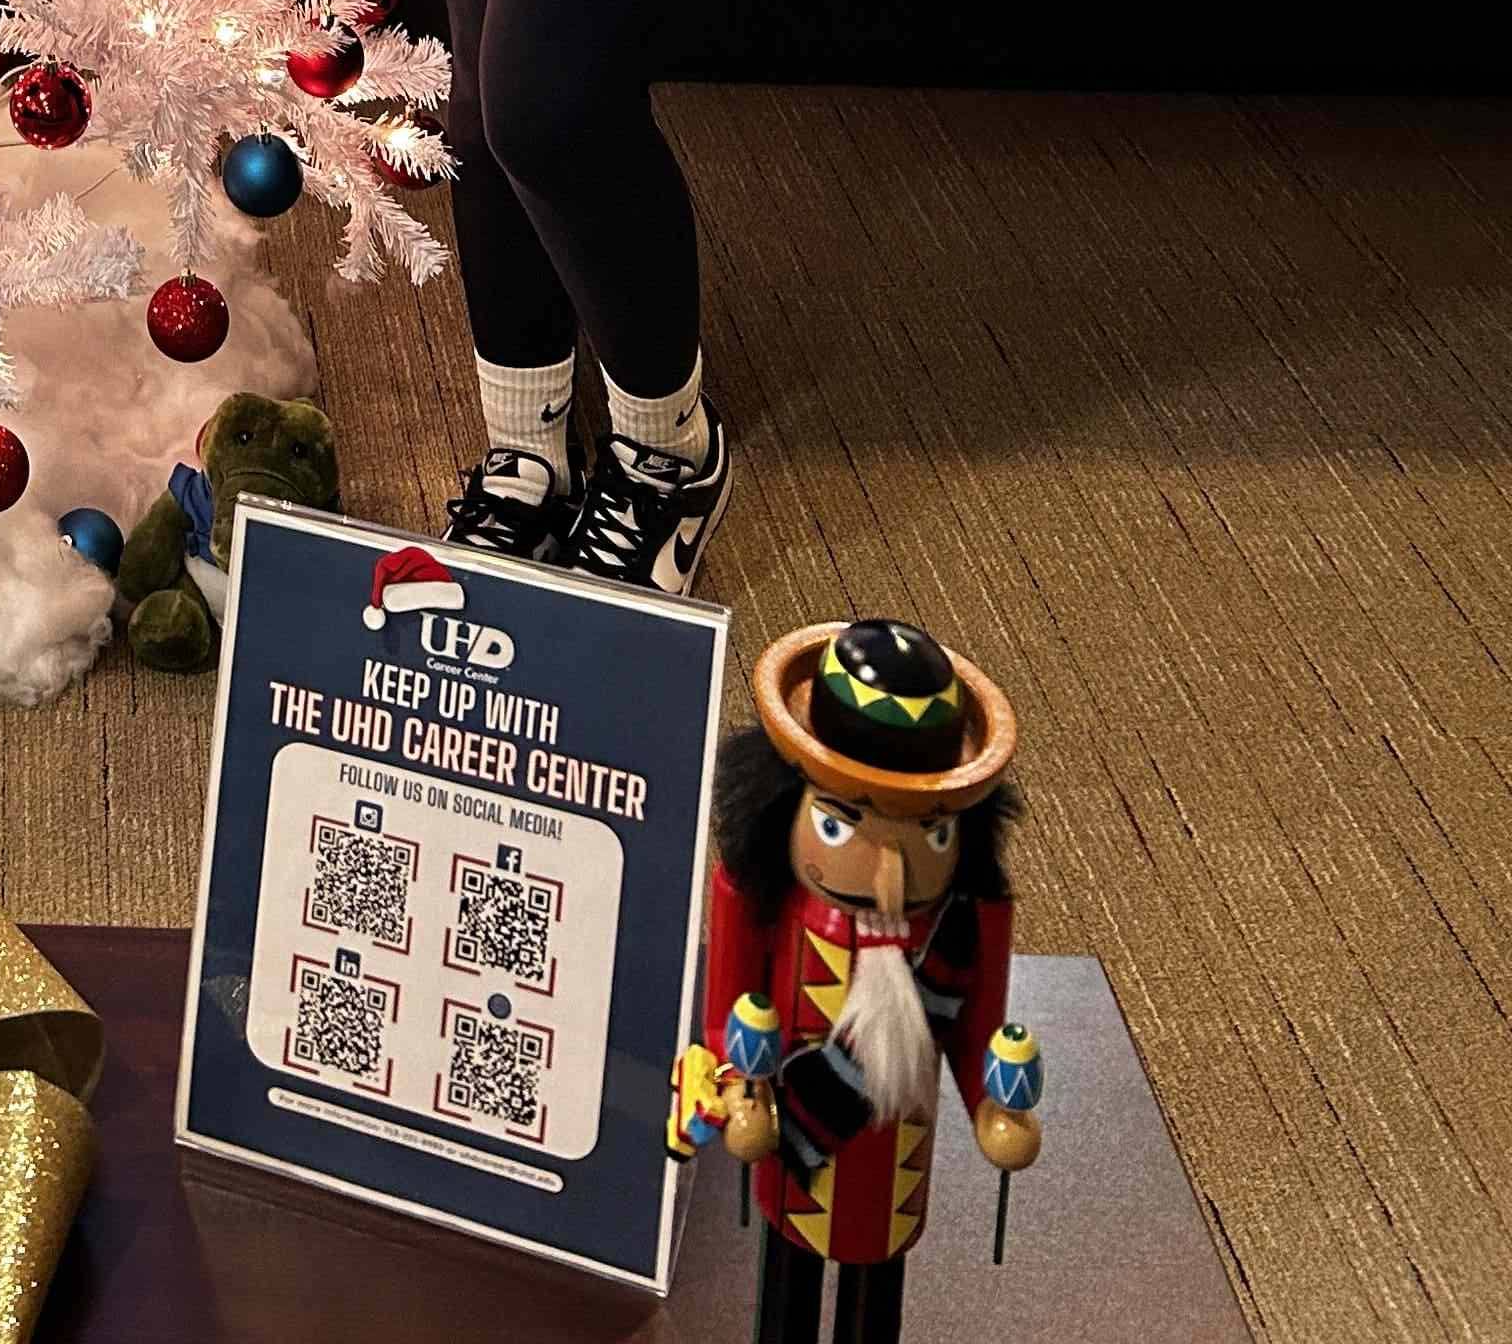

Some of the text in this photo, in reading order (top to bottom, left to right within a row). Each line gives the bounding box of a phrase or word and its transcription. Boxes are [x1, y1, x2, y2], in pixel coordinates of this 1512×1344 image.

[419, 611, 515, 669] UHD
[426, 656, 499, 684] Career Center
[362, 659, 560, 745] KEEP UP WITH
[269, 681, 648, 821] THE UHD CAREER CENTER
[339, 763, 564, 842] FOLLOW US ON SOCIAL MEDIA!
